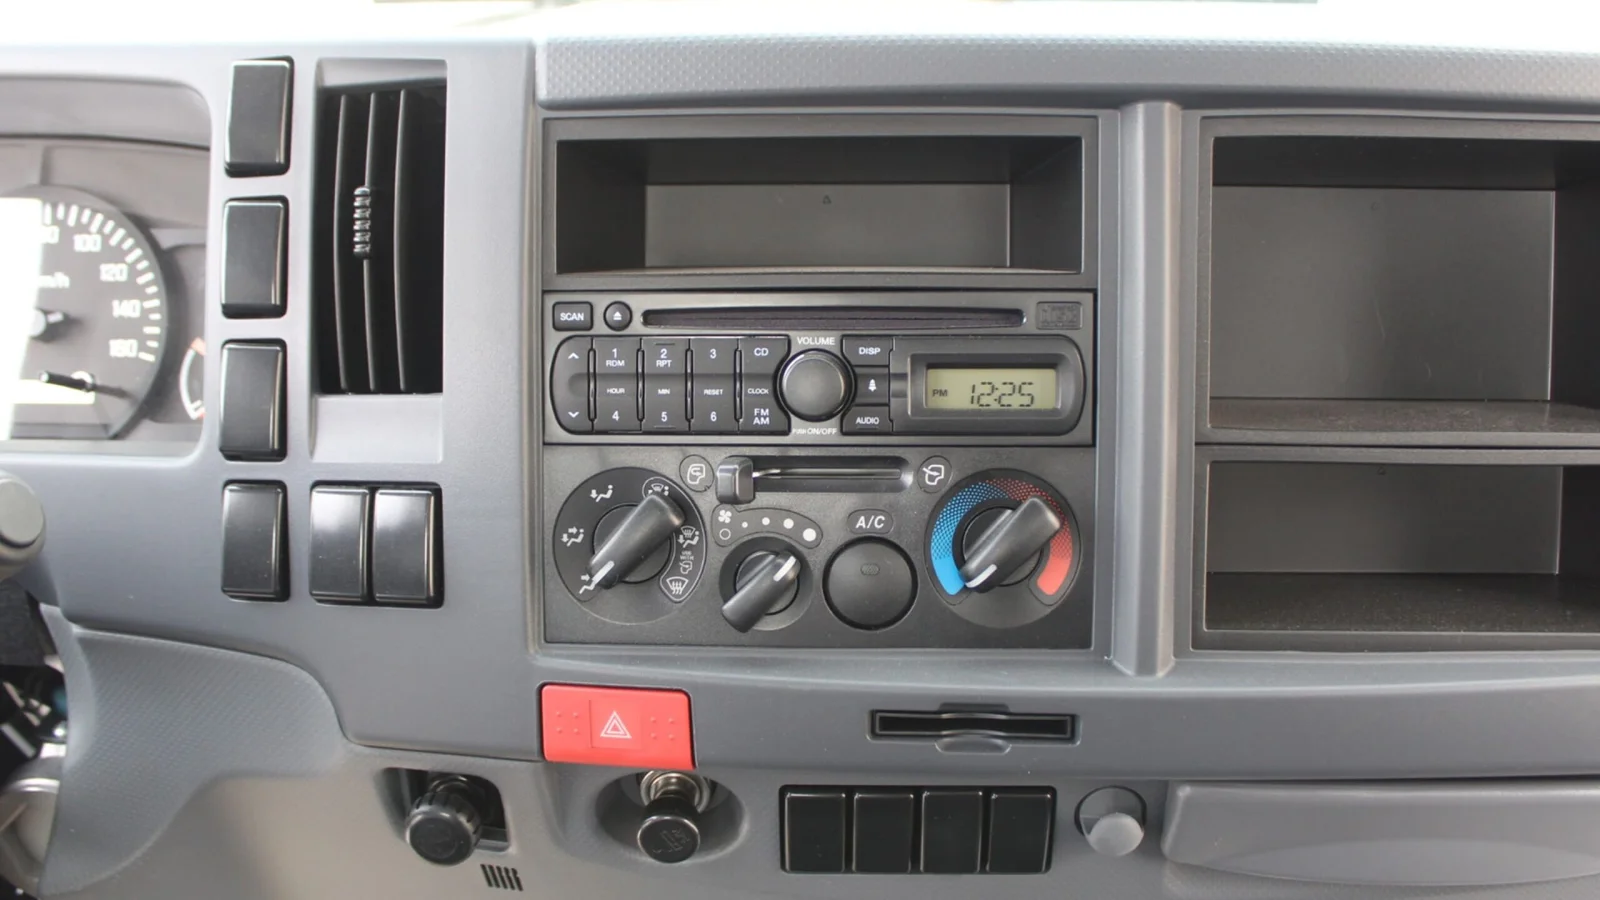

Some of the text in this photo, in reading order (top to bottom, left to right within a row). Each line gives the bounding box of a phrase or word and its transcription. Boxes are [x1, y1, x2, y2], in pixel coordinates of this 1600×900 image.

[73, 233, 102, 252] 100
[100, 263, 128, 281] 120
[112, 300, 141, 317] 140
[559, 312, 585, 321] SCAN
[796, 336, 835, 346] VOLUME
[612, 347, 618, 359] 1
[660, 348, 668, 359] 2
[709, 348, 717, 359] 3
[753, 347, 769, 357] CD
[858, 346, 881, 355] DISP
[605, 359, 625, 367] RDM
[655, 359, 672, 368] RPT
[703, 388, 724, 396] RESET
[747, 387, 769, 395] CLOCK
[931, 381, 1035, 407] PM 12:25
[611, 410, 620, 421] 4
[710, 411, 717, 422] 6
[753, 407, 770, 416] FM
[661, 411, 668, 423] 5
[752, 416, 770, 425] AM
[855, 416, 880, 425] AUDIO
[806, 427, 838, 435] ON/OFF
[855, 515, 886, 529] A/C
